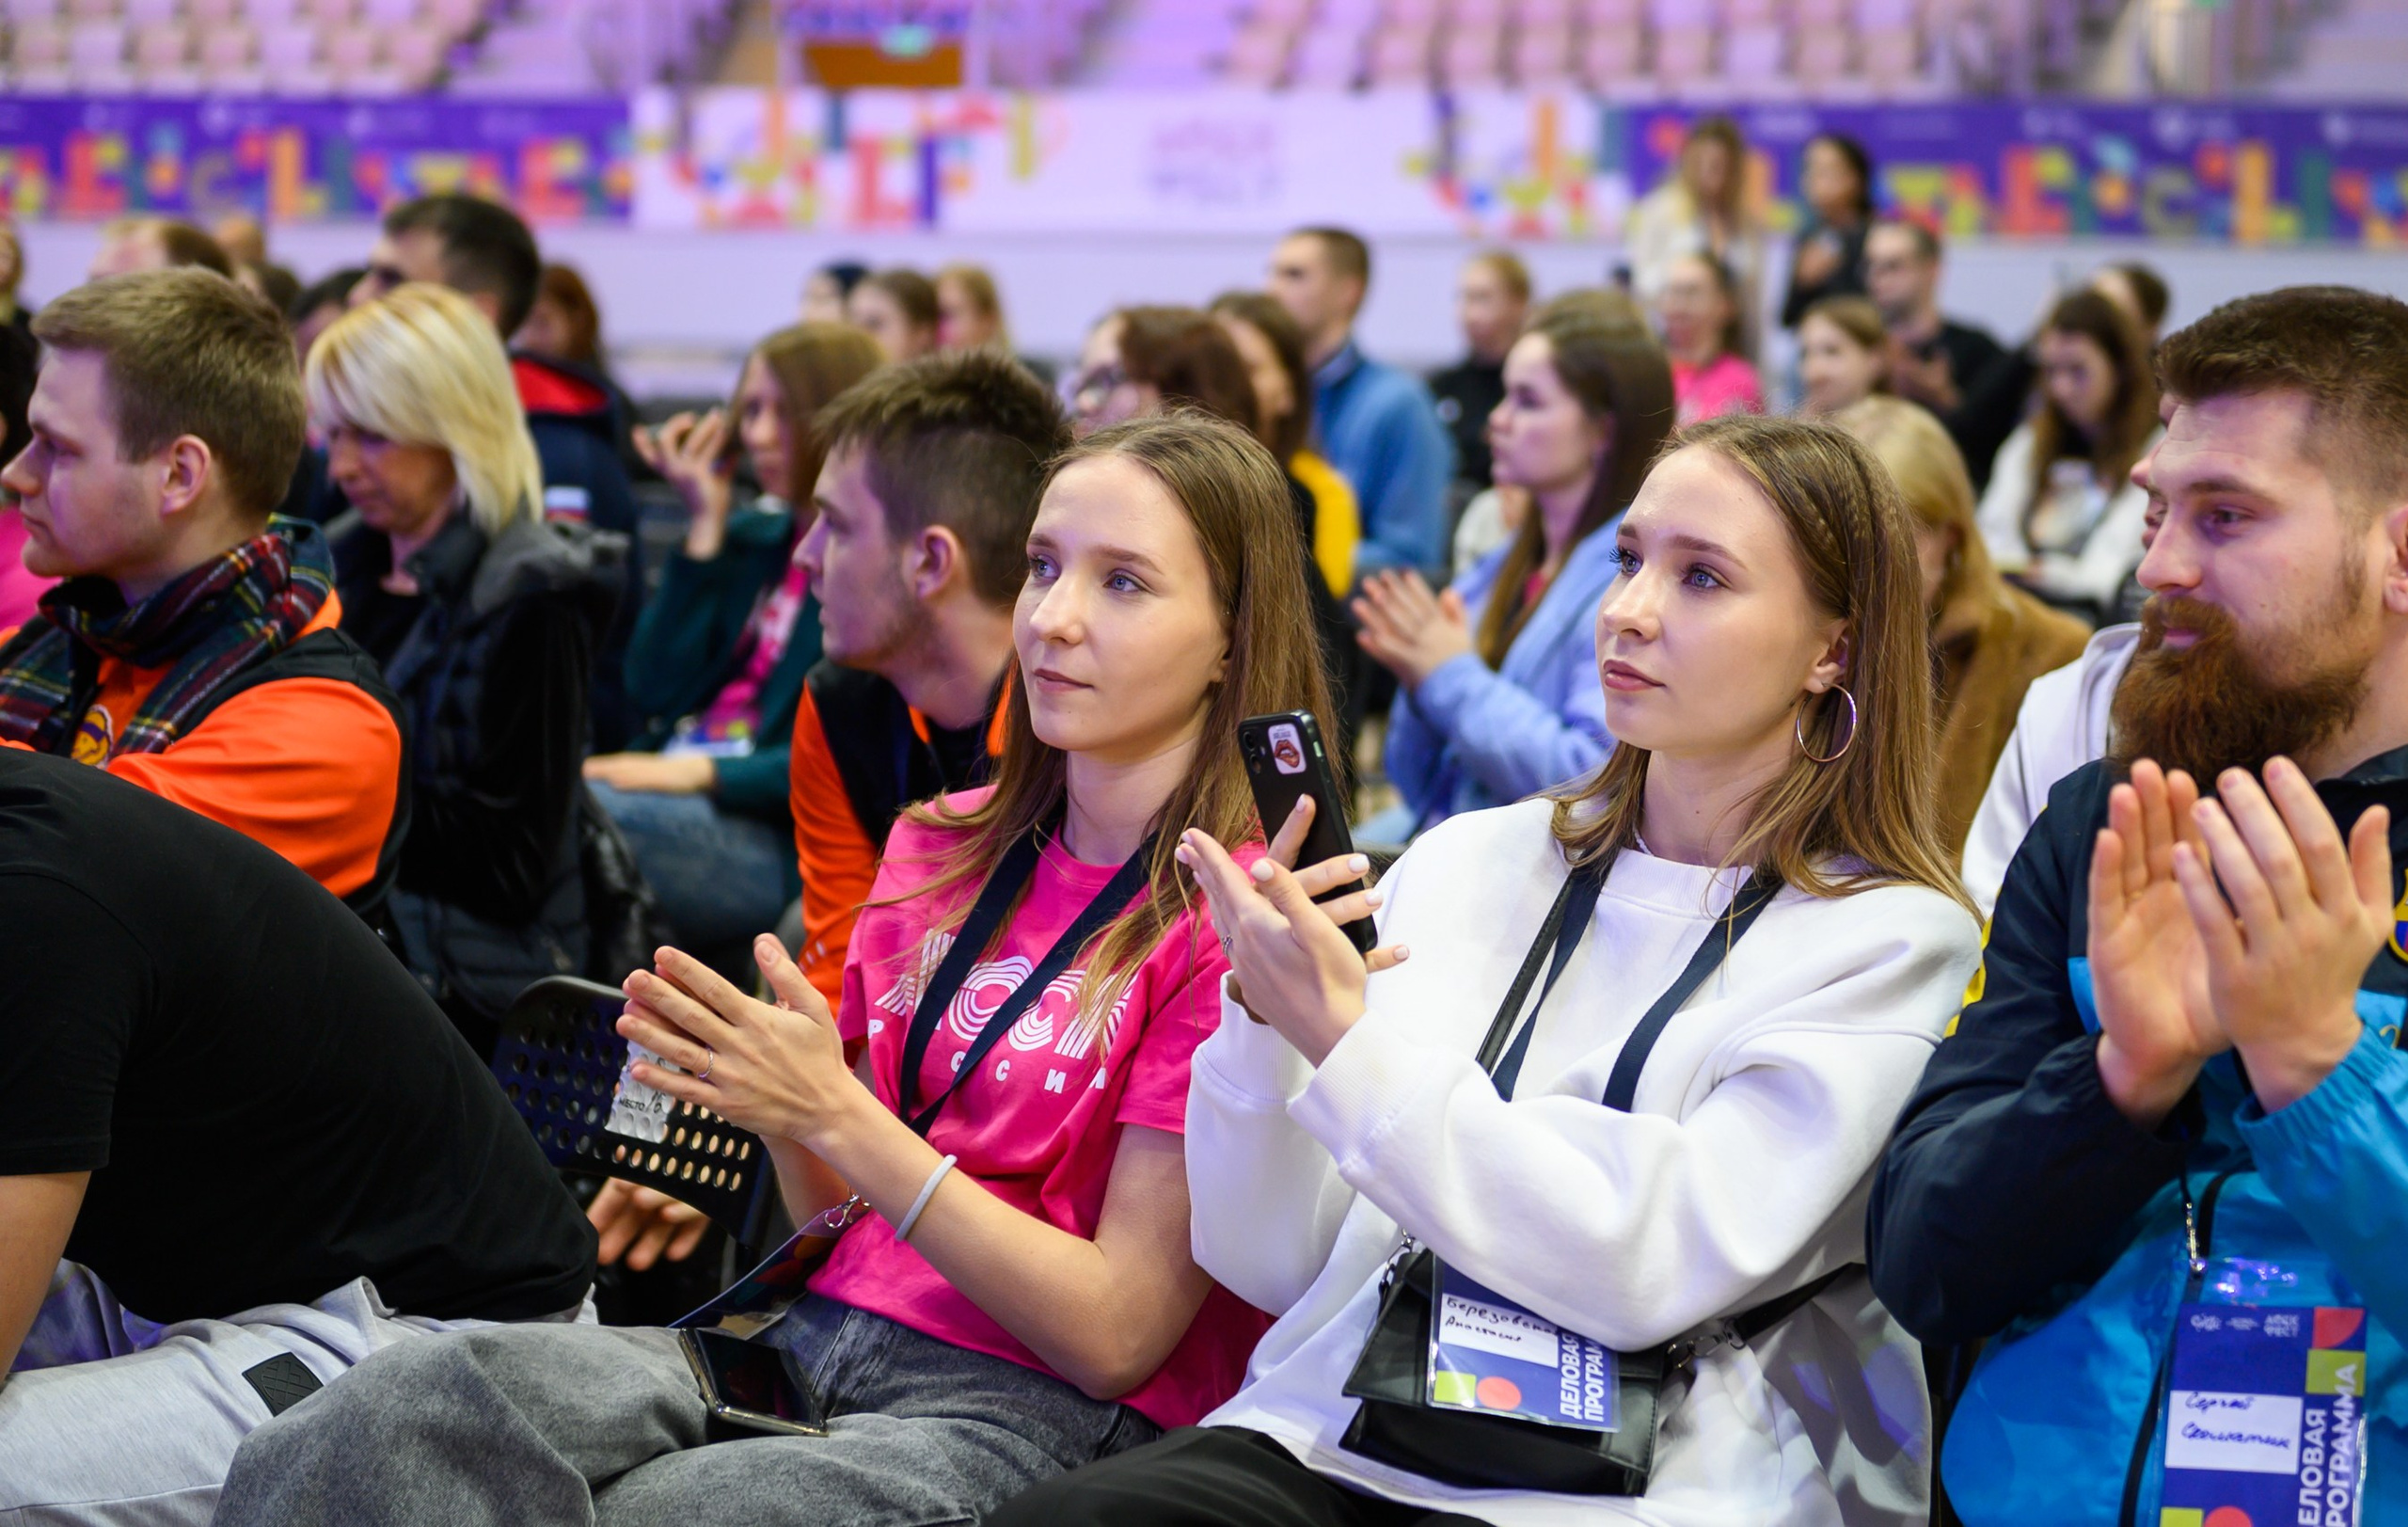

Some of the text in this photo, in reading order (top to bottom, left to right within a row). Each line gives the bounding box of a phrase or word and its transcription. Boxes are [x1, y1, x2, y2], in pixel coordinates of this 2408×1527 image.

[1560, 1332, 1582, 1420] ДЕЛОВАЯ
[2298, 1408, 2326, 1526] ЕЛОВАЯ
[2325, 1363, 2357, 1527] РОГРАММА
